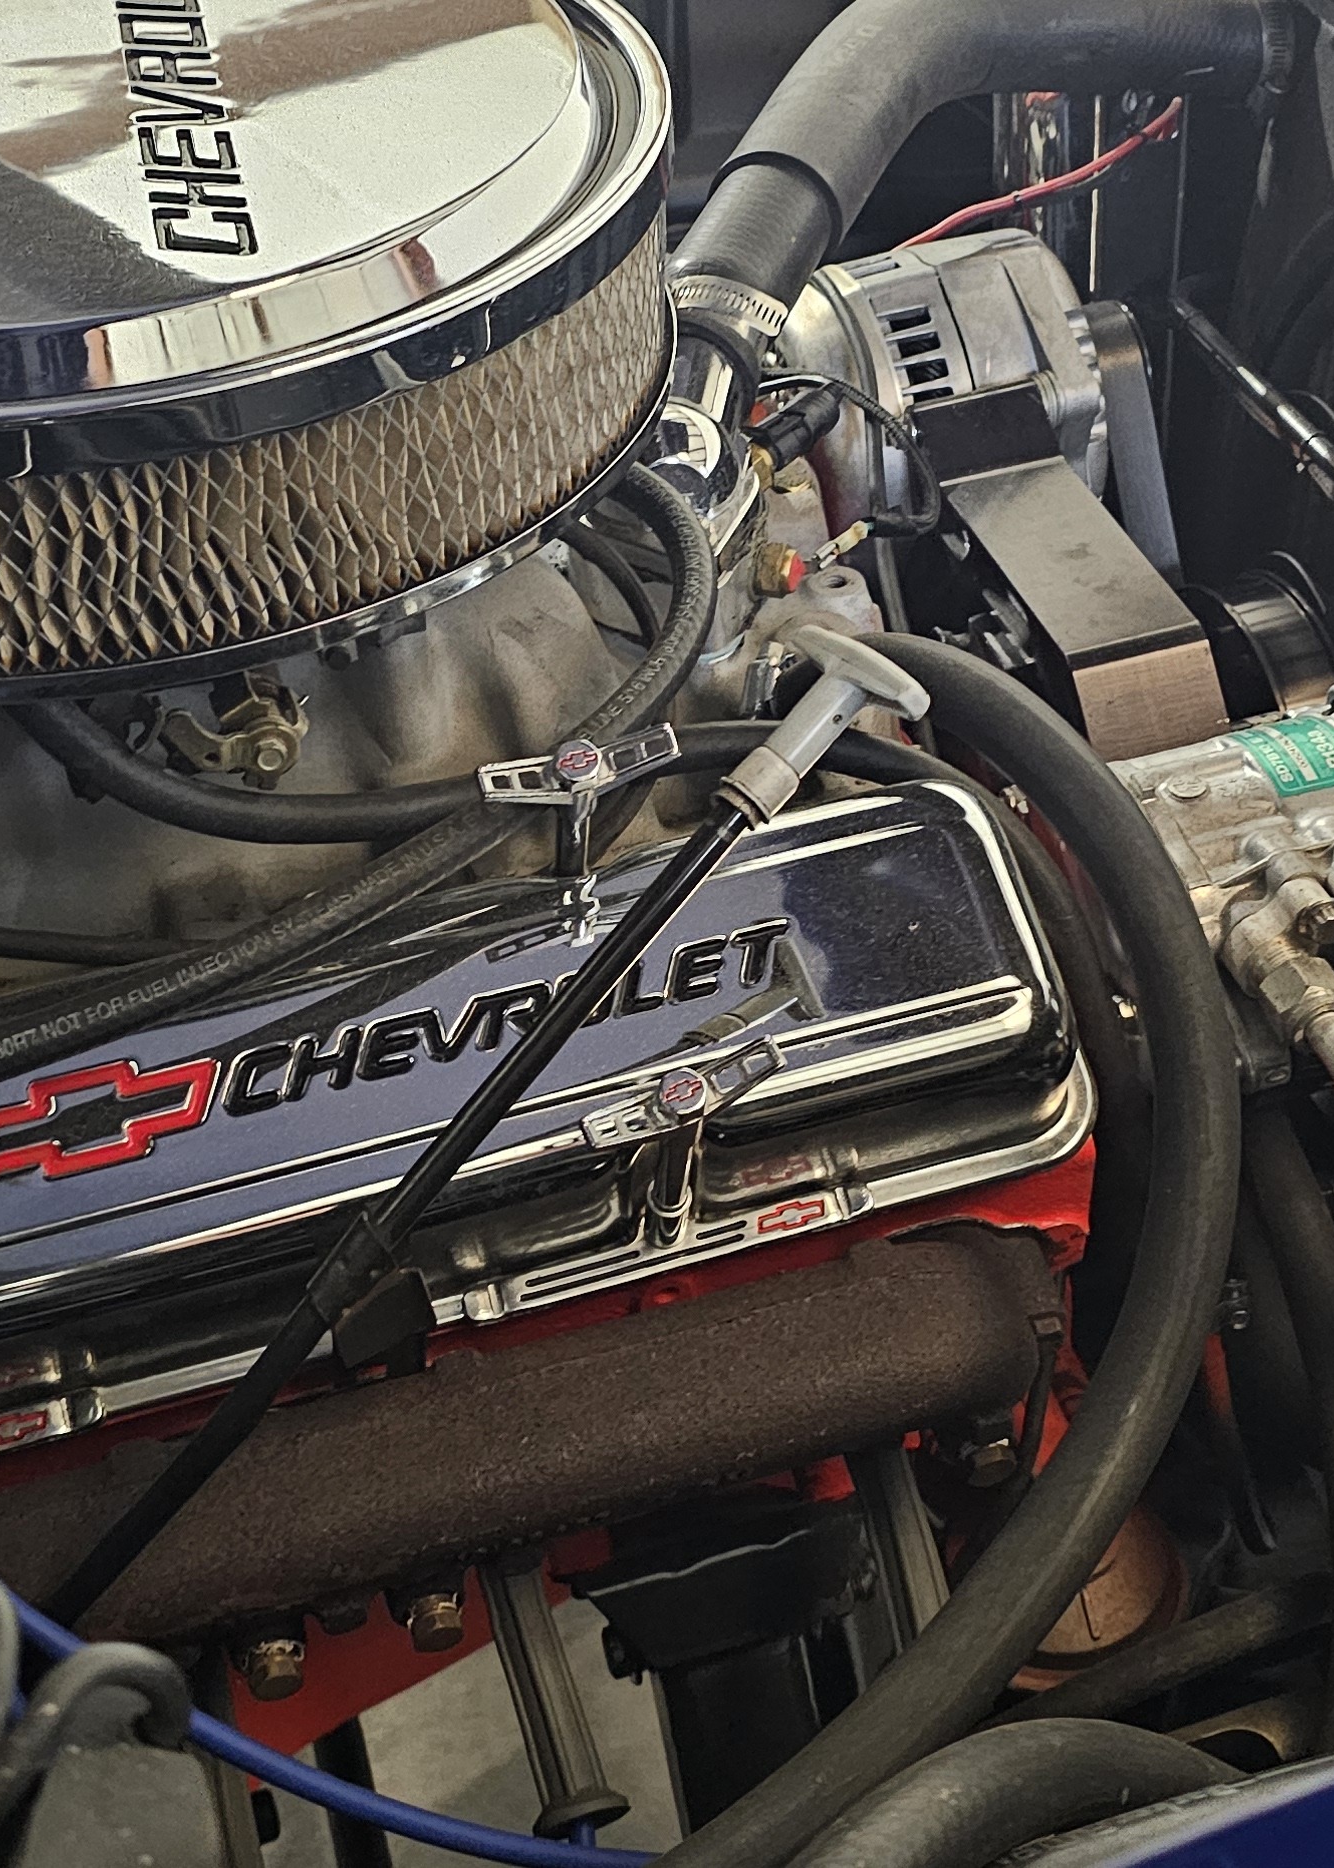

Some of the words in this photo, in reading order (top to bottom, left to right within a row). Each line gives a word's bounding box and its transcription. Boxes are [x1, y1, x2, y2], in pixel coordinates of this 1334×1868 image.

[38, 1008, 85, 1042] NOT
[82, 993, 128, 1027] FOR
[123, 971, 178, 1010] FUEL
[173, 929, 274, 990] INJECTION
